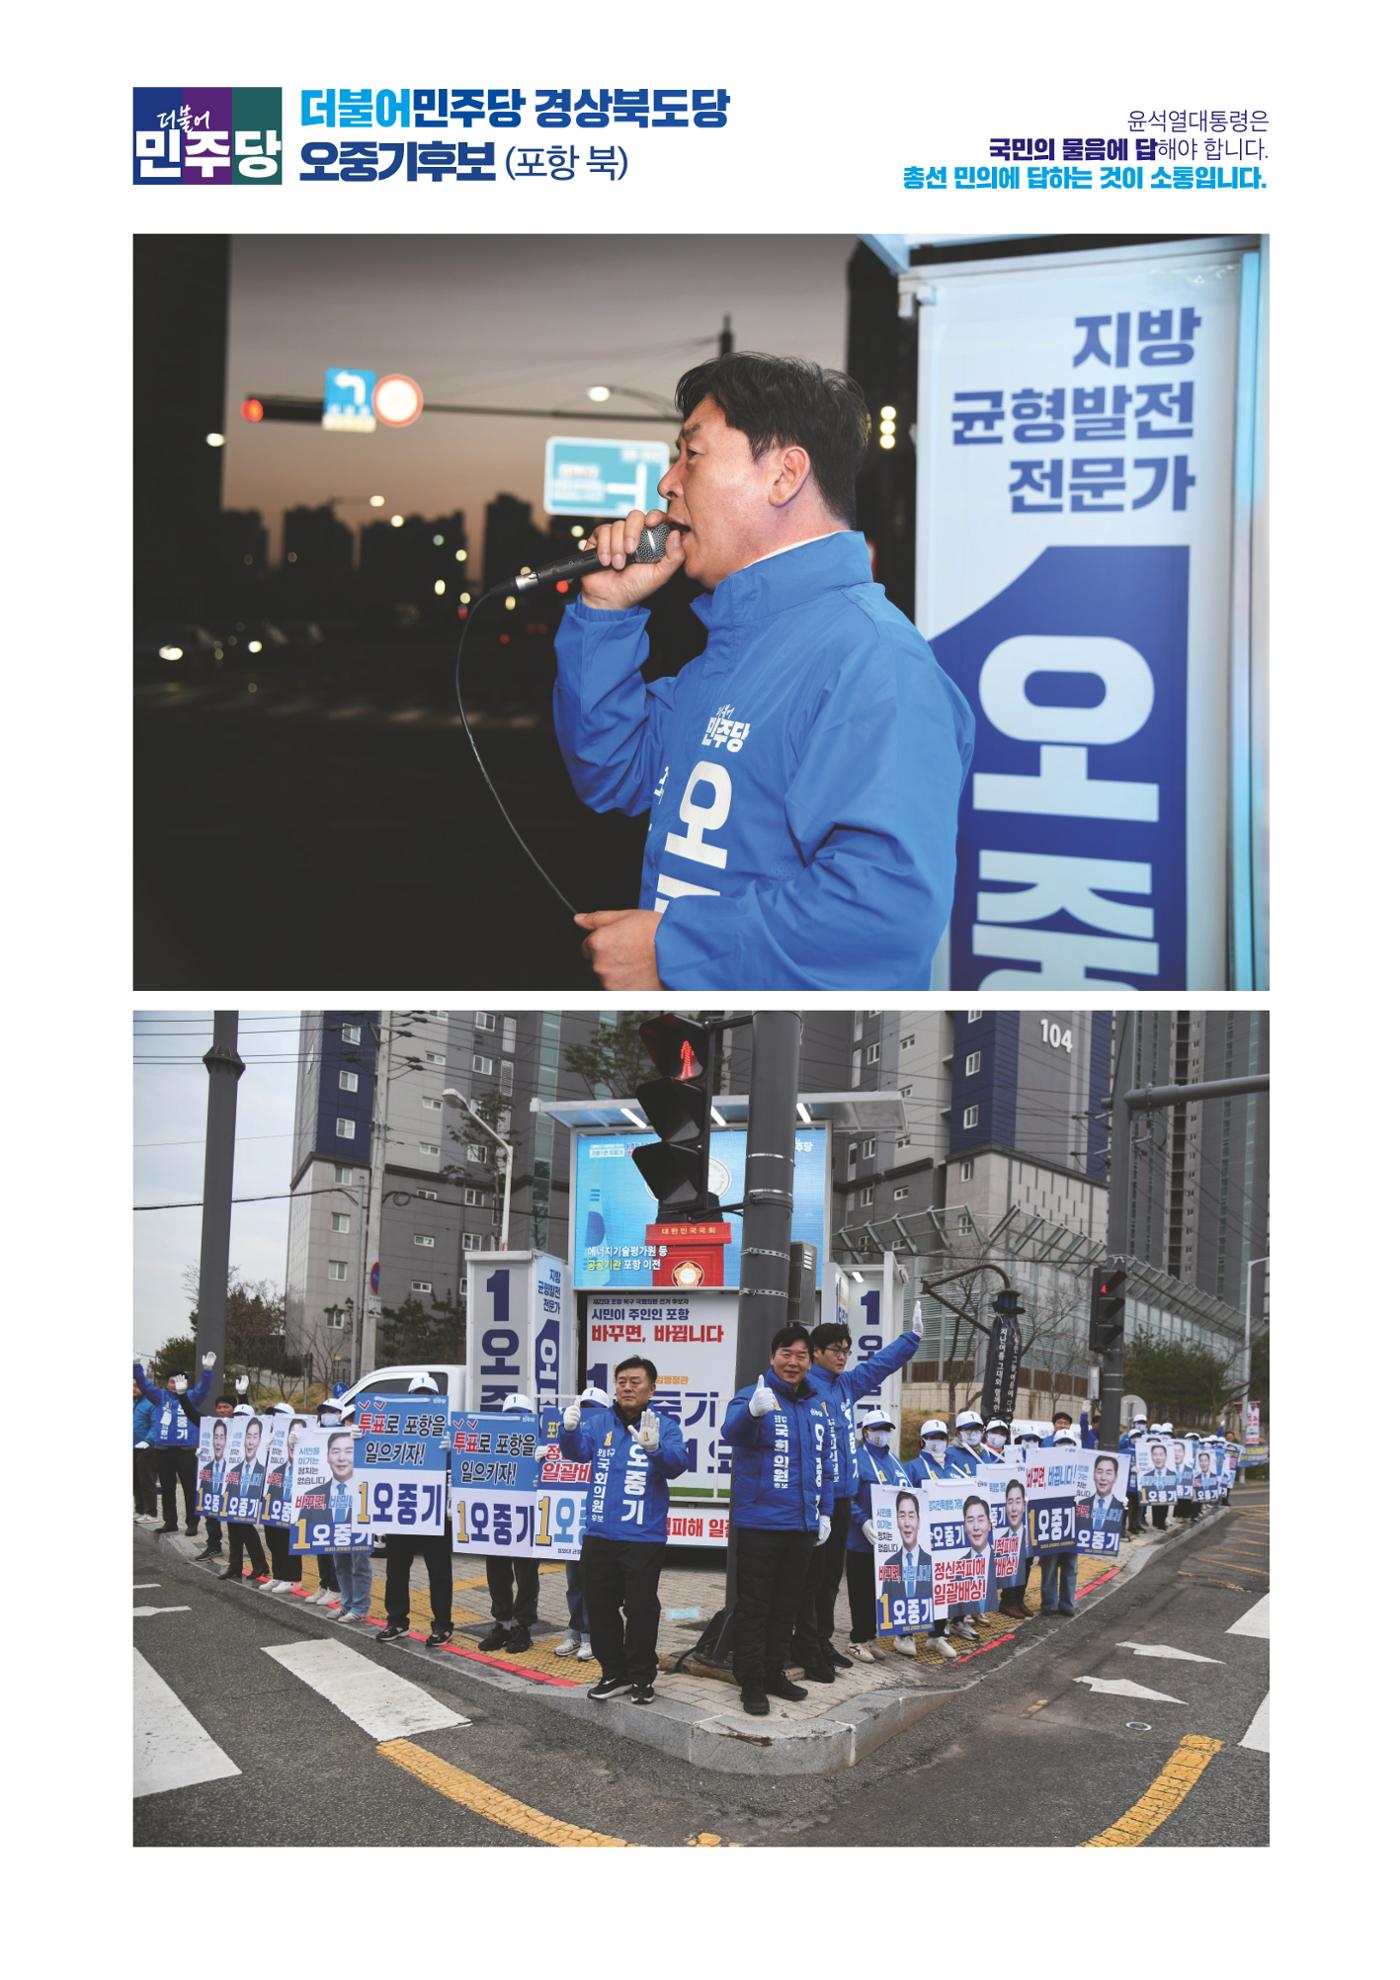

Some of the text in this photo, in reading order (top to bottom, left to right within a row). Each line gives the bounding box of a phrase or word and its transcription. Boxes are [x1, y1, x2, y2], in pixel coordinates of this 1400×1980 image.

[1072, 306, 1200, 368] 지방
[951, 381, 1195, 445] 균형발전
[1008, 455, 1196, 513] 전문가
[701, 717, 750, 753] 민주당
[1041, 1018, 1072, 1053] 104
[623, 1260, 641, 1271] 포항
[644, 1260, 661, 1271] 이전
[487, 1269, 509, 1321] 1
[861, 1290, 880, 1325] 1
[592, 1308, 689, 1321] 시민이 주인인 포항
[592, 1324, 724, 1344] 바꾸면, 바뀝니다
[358, 1413, 446, 1438] 투표로 포항을
[365, 1442, 425, 1465] 일으키자!
[453, 1433, 536, 1457] 투표로 포항을
[461, 1461, 517, 1487] 일으키자!
[592, 1458, 610, 1514] 국회의원
[204, 1493, 220, 1513] 오중
[357, 1481, 442, 1526] 1 오중기
[1148, 1490, 1177, 1503] 오중기
[271, 1500, 292, 1522] 오중
[457, 1500, 534, 1547] 1 오중기
[535, 1496, 552, 1547] 1
[292, 1518, 311, 1550] 1
[933, 1526, 966, 1547] 오중기
[1027, 1506, 1076, 1547] 1 오중기
[994, 1537, 1019, 1557] 적피해
[1076, 1530, 1119, 1552] 오중기
[934, 1558, 986, 1581] 정신적피해
[995, 1556, 1018, 1577] 배상!
[934, 1582, 986, 1606] 일괄배상!
[880, 1593, 934, 1630] 1 오중기
